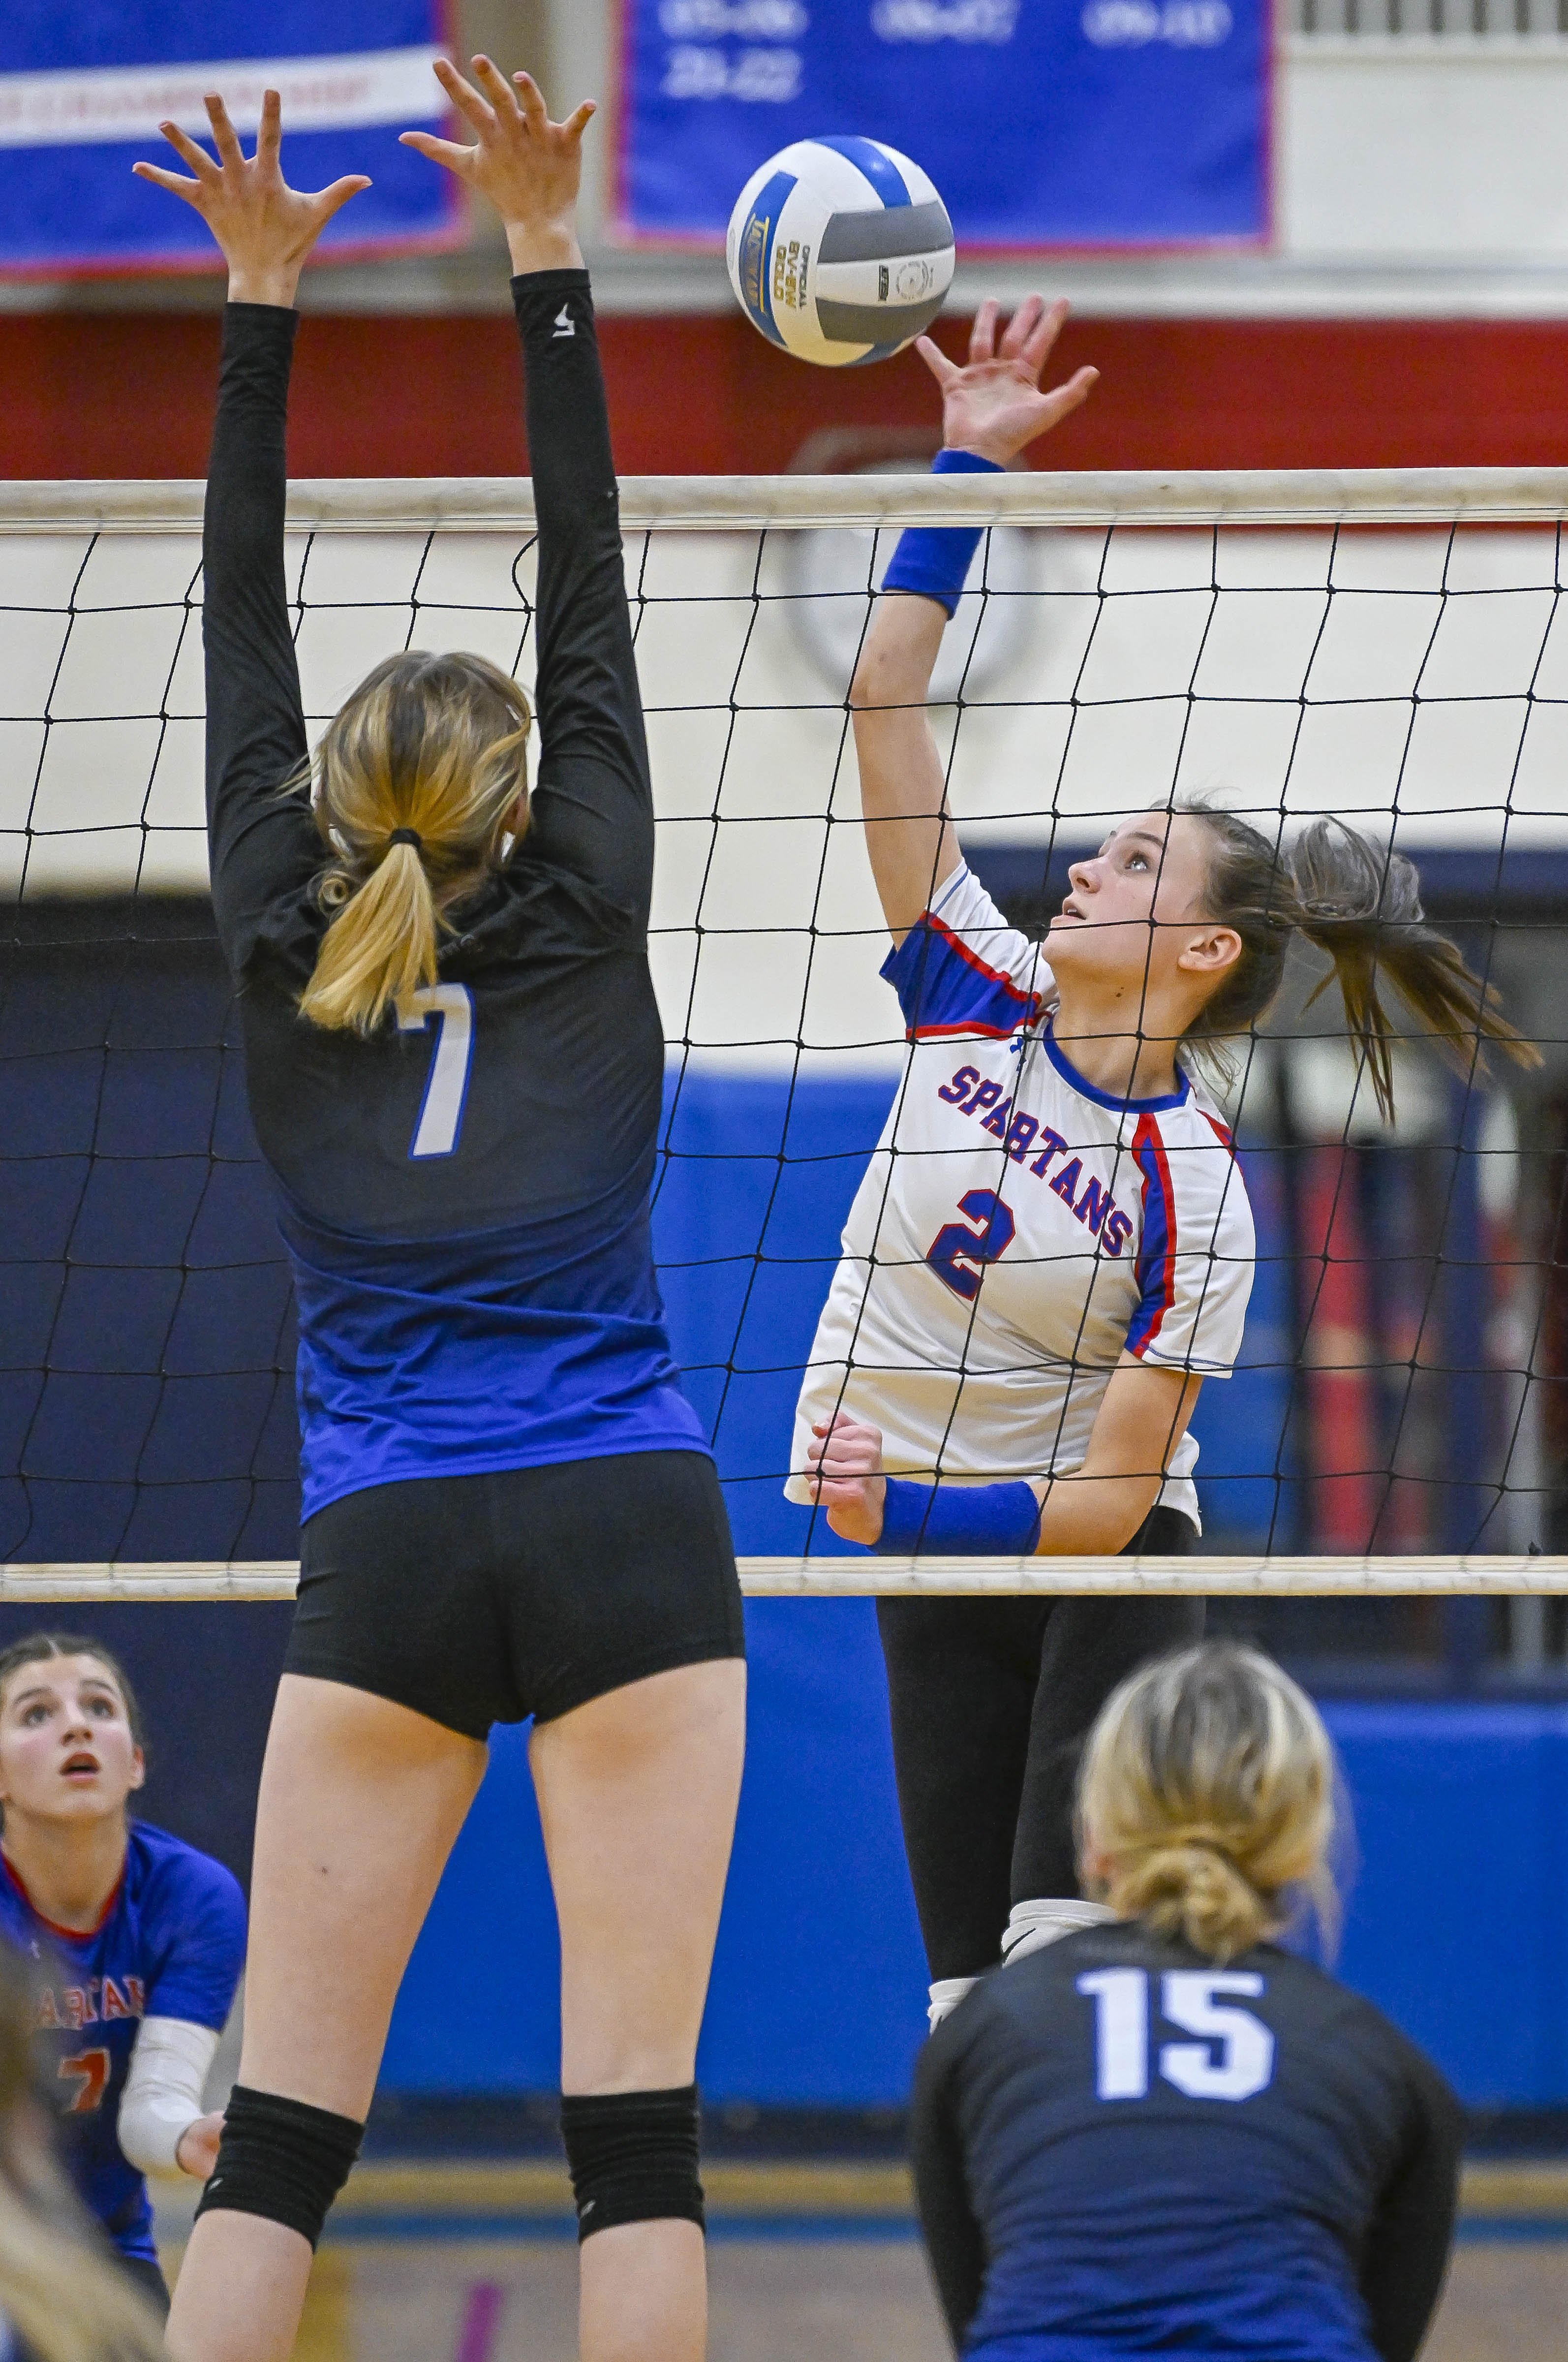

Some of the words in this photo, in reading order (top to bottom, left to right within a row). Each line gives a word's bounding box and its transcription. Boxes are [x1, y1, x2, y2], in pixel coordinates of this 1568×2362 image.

[393, 982, 475, 1160] 7
[938, 1065, 1133, 1257] SPARTANS
[926, 1188, 1016, 1301] 2
[57, 2047, 111, 2114] 7
[1076, 1966, 1275, 2102] 15
